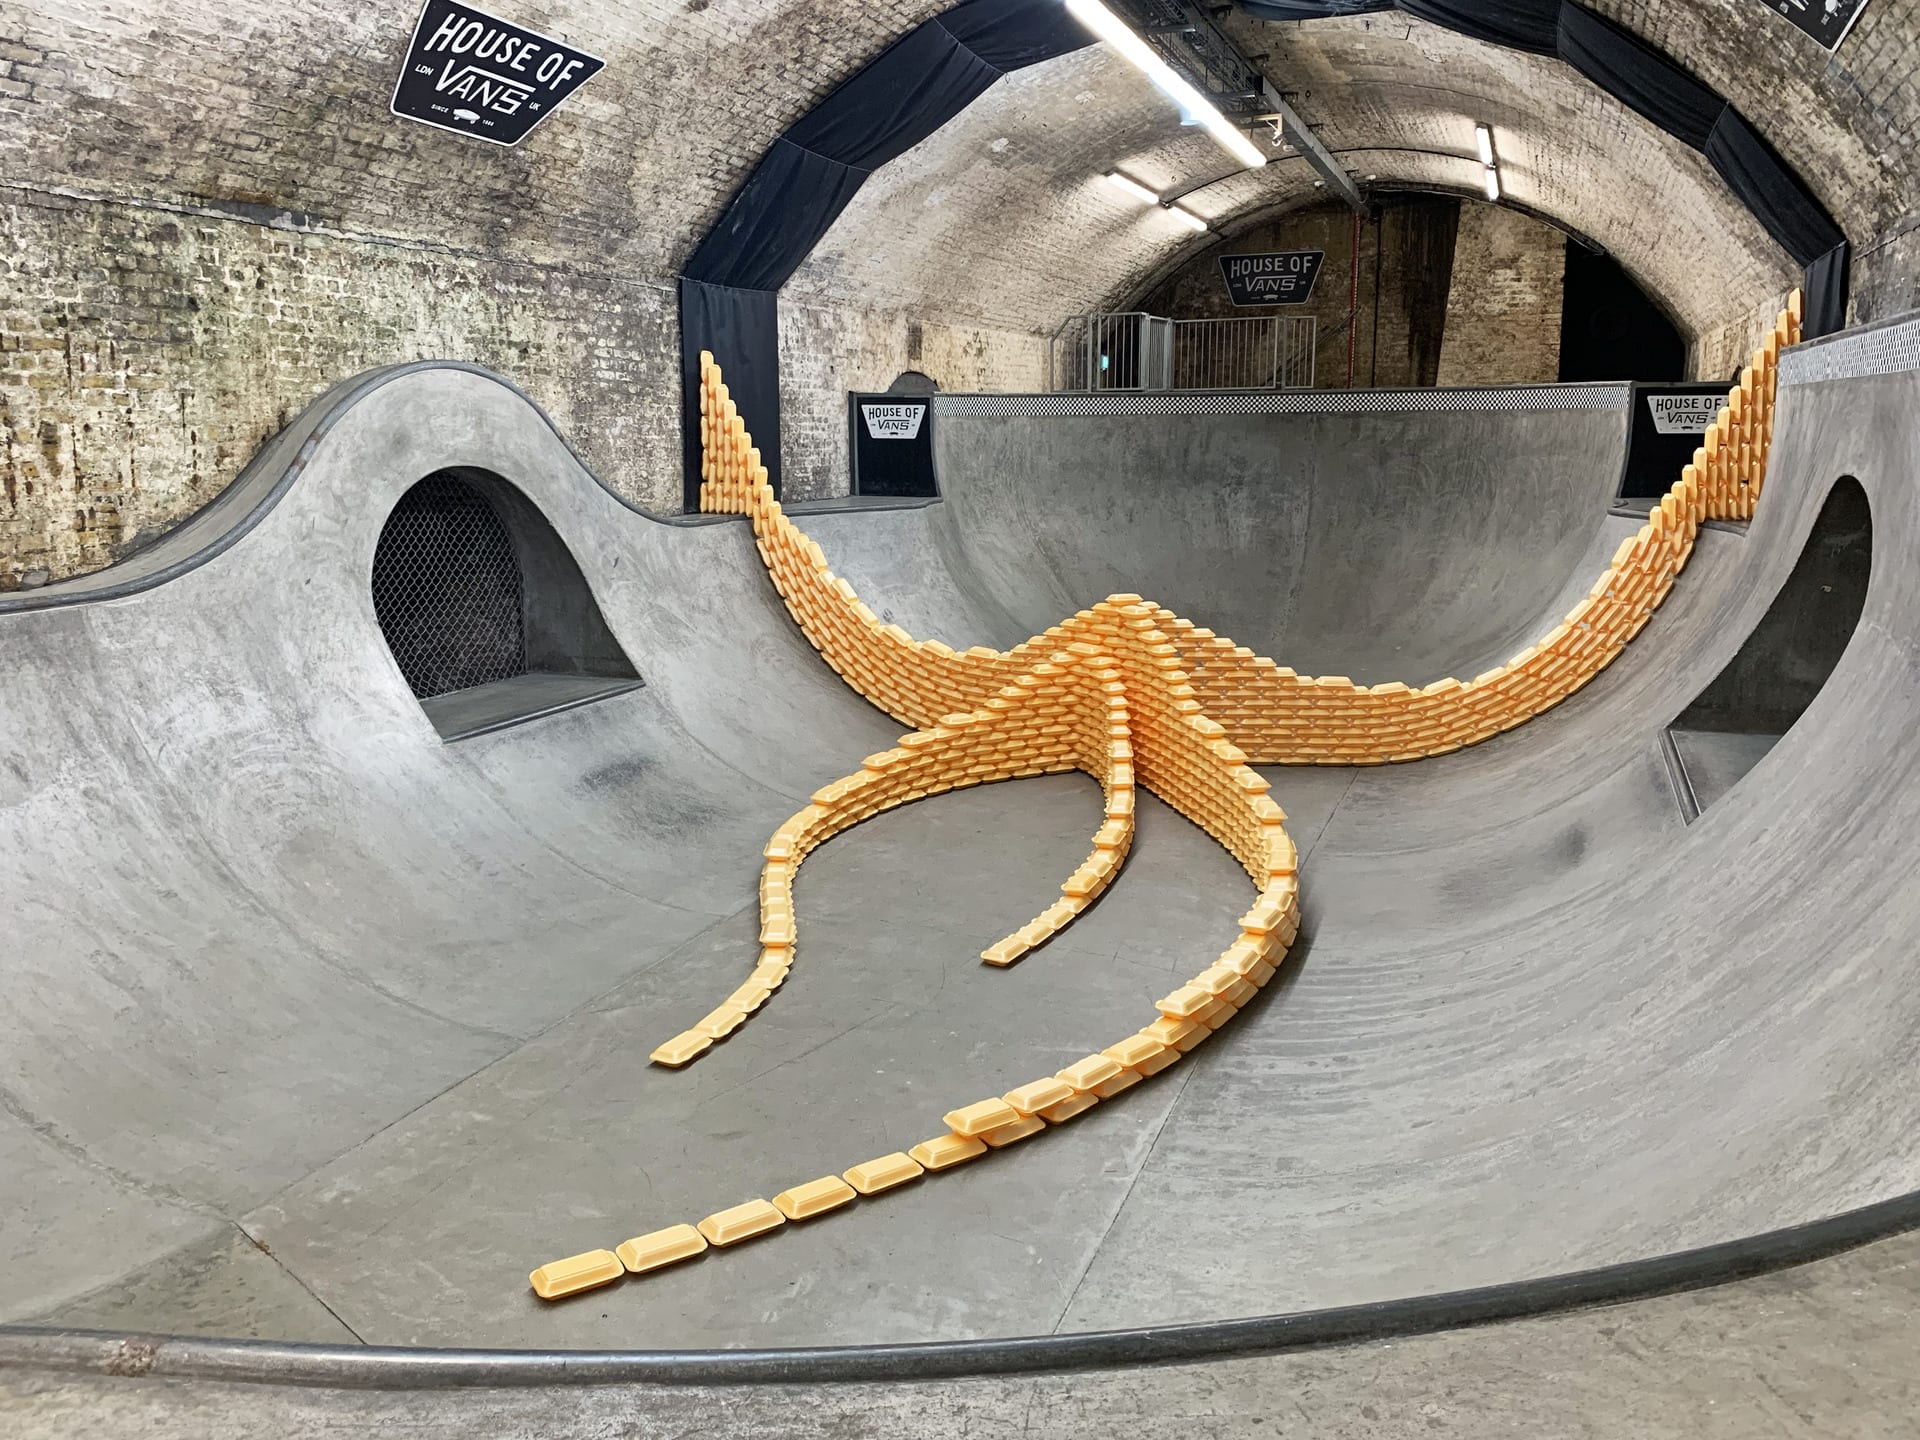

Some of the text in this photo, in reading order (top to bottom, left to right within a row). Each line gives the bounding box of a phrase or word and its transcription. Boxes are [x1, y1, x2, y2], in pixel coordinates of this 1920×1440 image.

[424, 13, 584, 91] HOUSE OF
[415, 59, 541, 115] LDN VANS UK
[431, 104, 449, 113] SINCE
[1231, 256, 1313, 279] HOUSE OF
[1245, 275, 1297, 292] VANS
[1656, 398, 1722, 413] HOUSE OF
[868, 407, 919, 420] HOUSE OF
[1667, 412, 1709, 424] VANS
[878, 419, 910, 431] VANS
